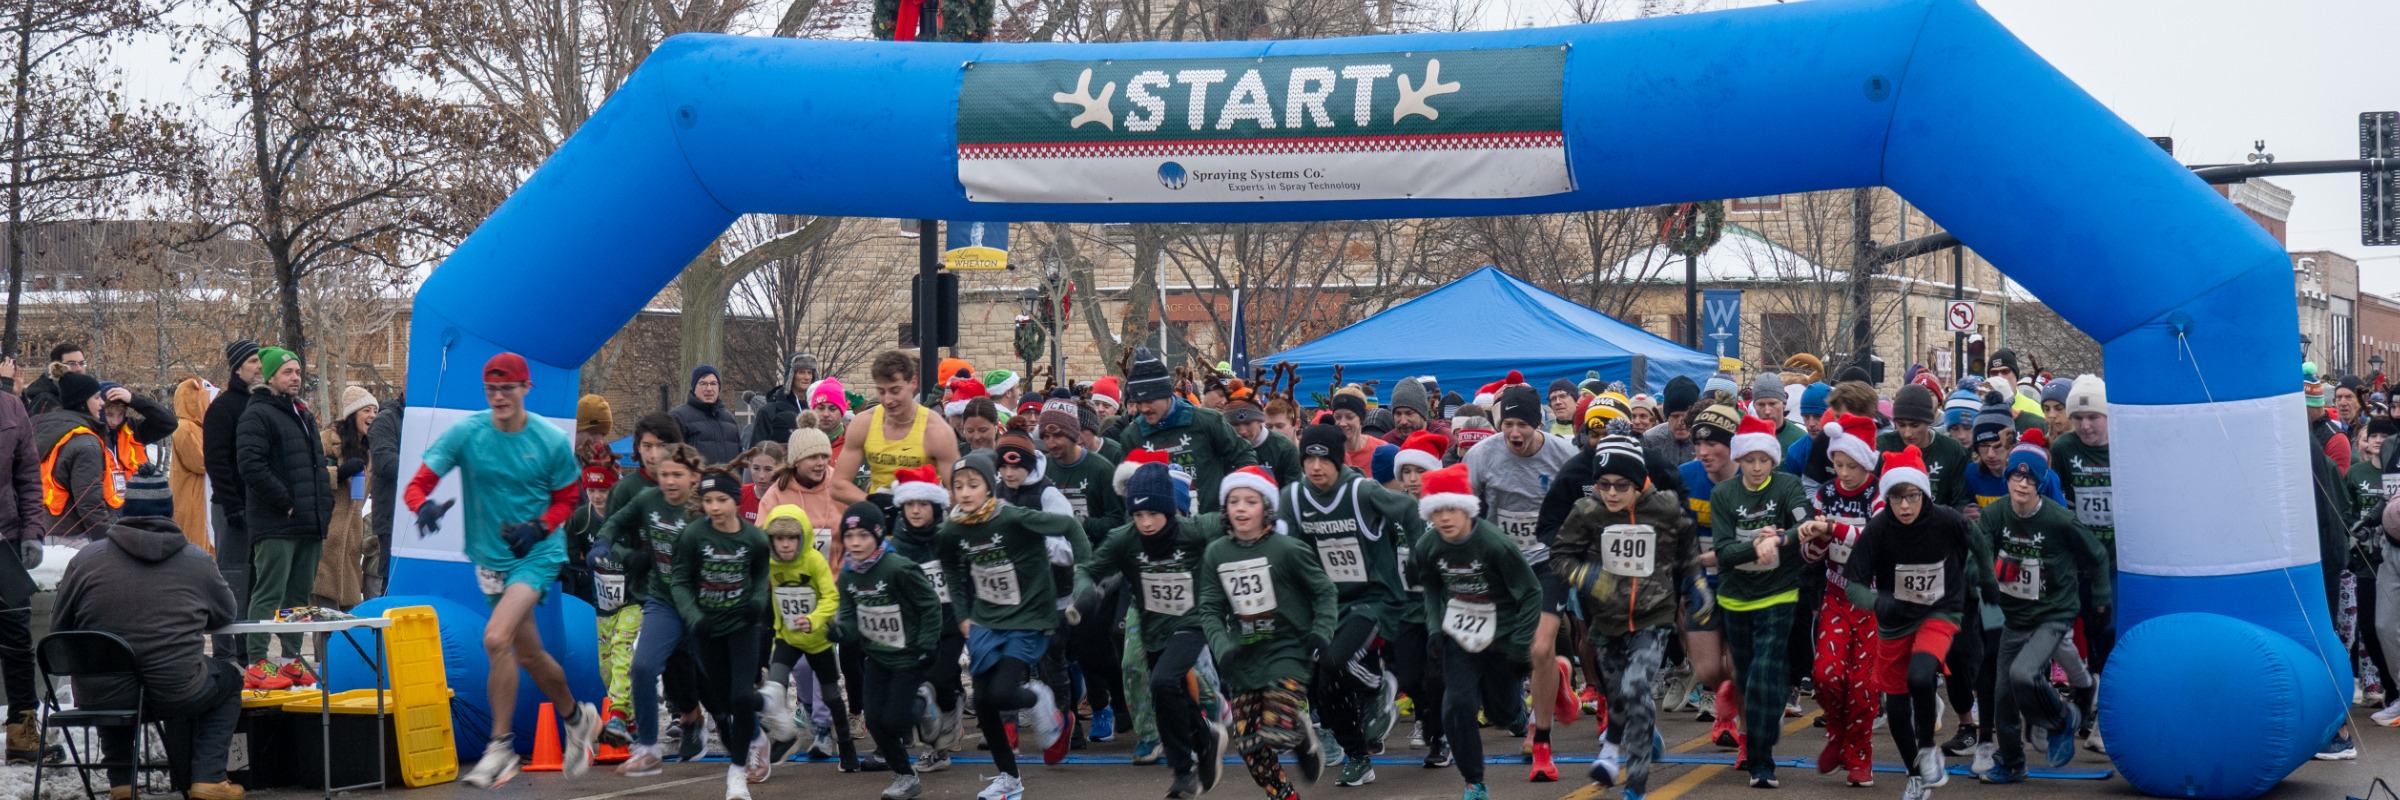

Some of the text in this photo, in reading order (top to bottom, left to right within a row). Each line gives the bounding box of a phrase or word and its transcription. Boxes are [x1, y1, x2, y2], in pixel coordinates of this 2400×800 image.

[1124, 64, 1393, 131] START
[1193, 170, 1247, 182] Spraying
[1250, 168, 1300, 180] Systems
[1228, 180, 1361, 193] Experts in Spray Technology
[955, 260, 998, 268] WHEATON
[1705, 299, 1740, 328] W
[2081, 497, 2111, 512] 751
[1301, 518, 1357, 535] SPARTANS
[1501, 520, 1538, 537] 1453
[1610, 538, 1646, 558] 490
[1327, 549, 1357, 567] 639
[1230, 573, 1263, 597] 253
[1903, 574, 1937, 591] 837
[597, 582, 621, 601] 1154
[1151, 584, 1185, 601] 532
[782, 599, 810, 615] 935
[862, 615, 900, 633] 1140
[1453, 613, 1488, 634] 327
